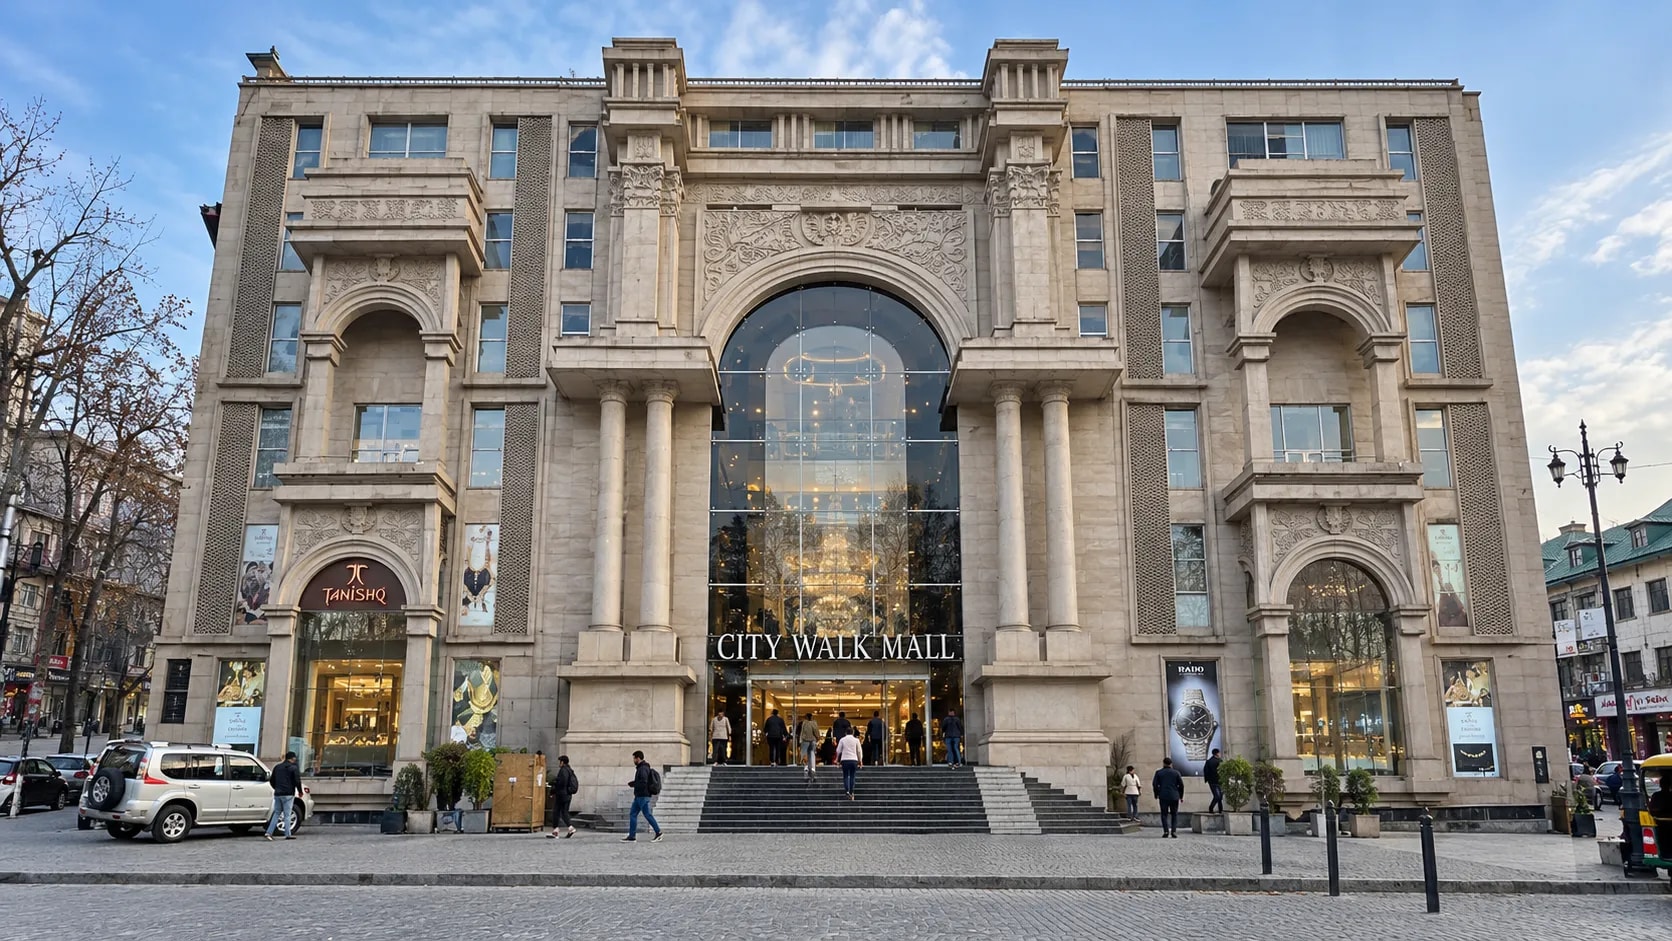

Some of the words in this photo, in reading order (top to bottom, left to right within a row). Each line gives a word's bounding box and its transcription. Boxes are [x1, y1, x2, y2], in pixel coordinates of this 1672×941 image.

[717, 633, 782, 660] CITY
[791, 633, 872, 660] WALK
[881, 633, 956, 660] MALL
[1178, 665, 1205, 673] RADO
